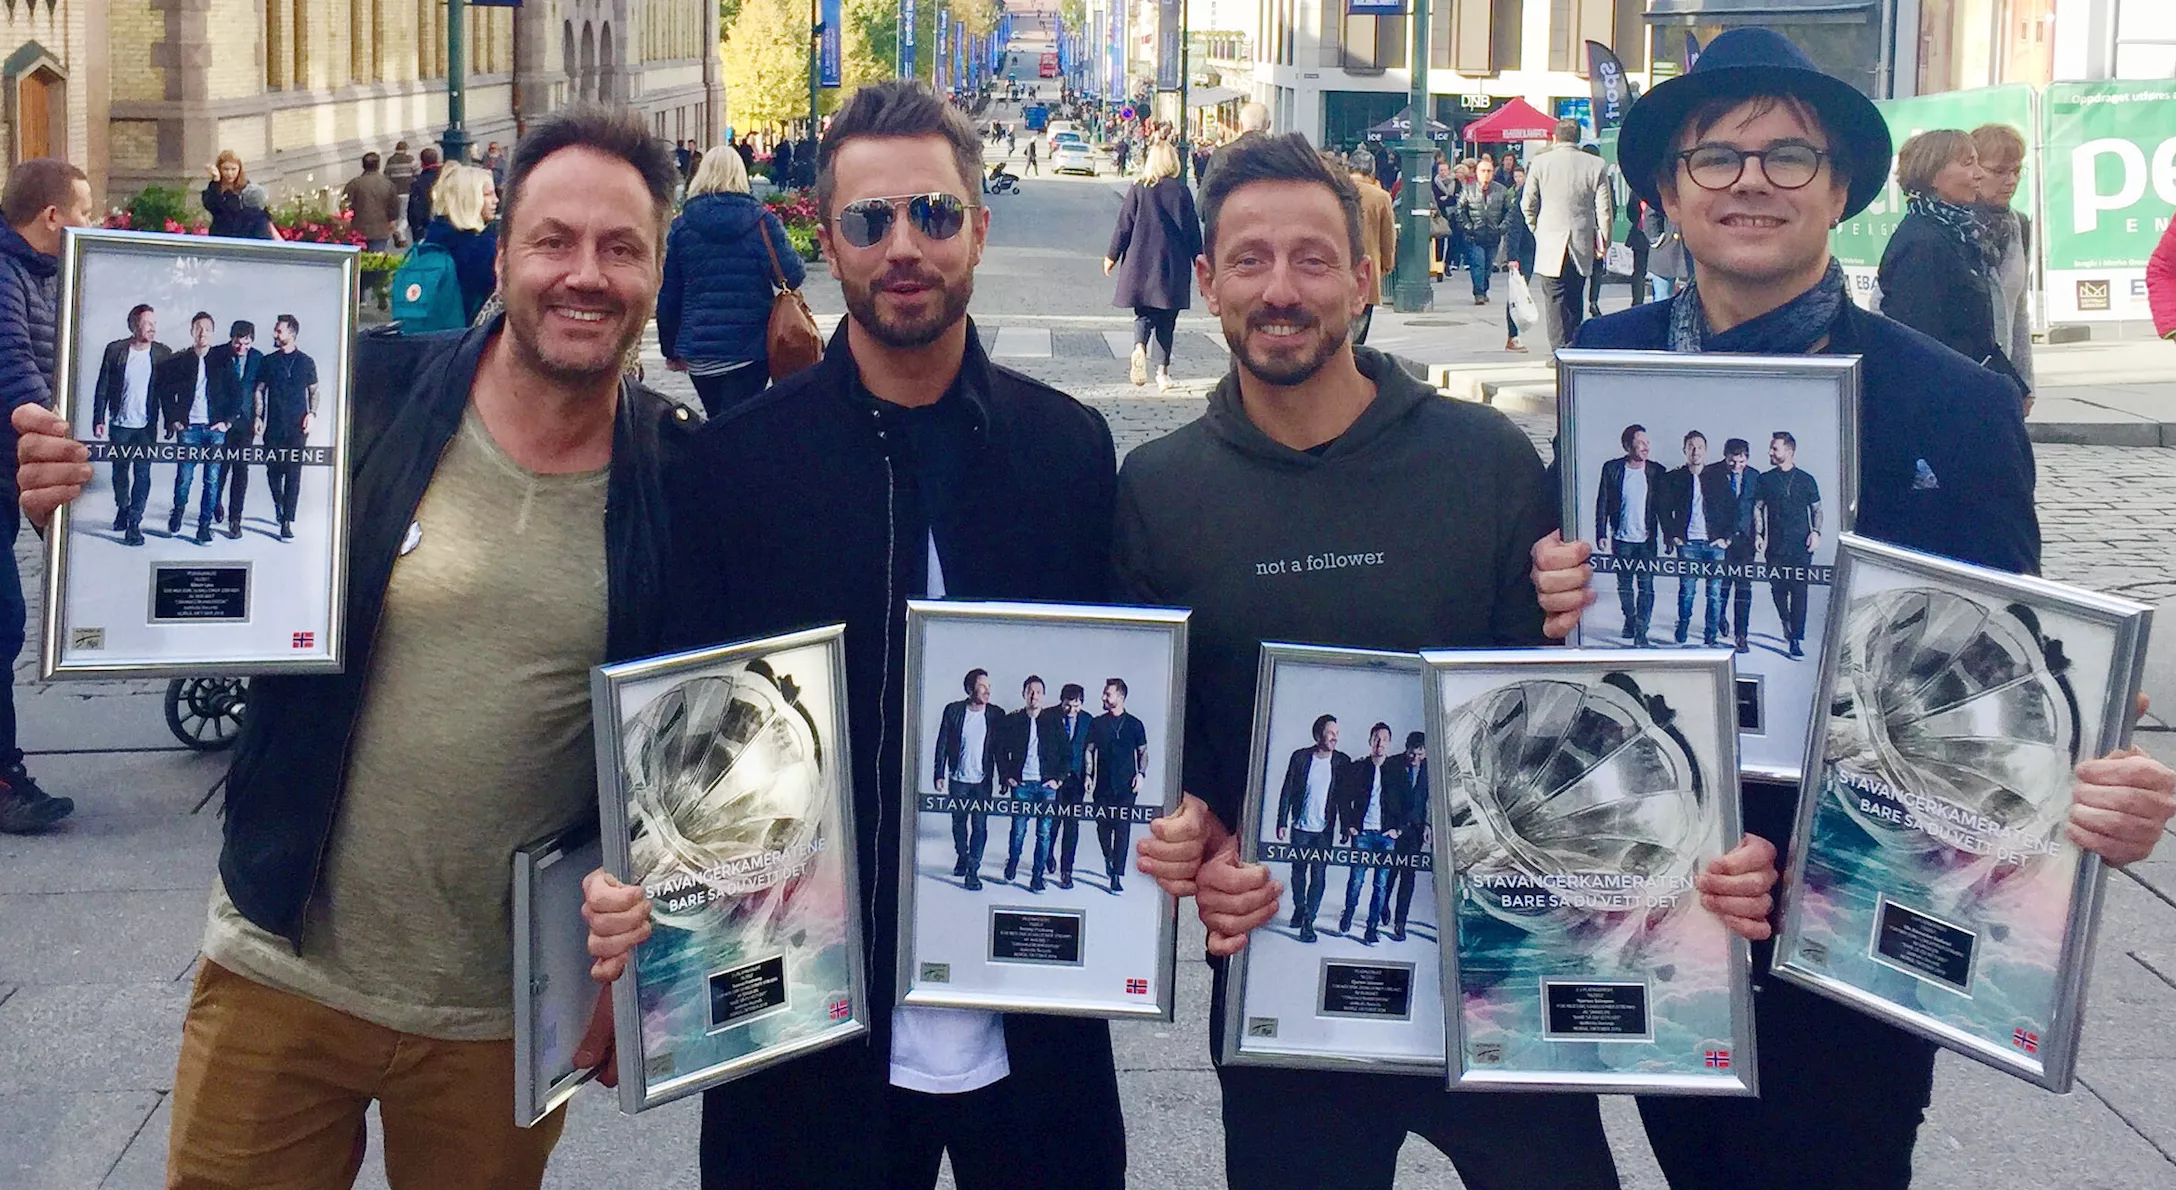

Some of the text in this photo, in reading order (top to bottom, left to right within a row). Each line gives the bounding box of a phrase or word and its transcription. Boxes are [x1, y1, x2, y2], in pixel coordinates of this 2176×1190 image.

[1461, 94, 1490, 110] DNB
[1367, 133, 1382, 141] ice
[1434, 132, 1449, 141] ice
[85, 444, 325, 463] STAVANGERKAMERATENE
[1255, 551, 1385, 575] not a follower
[1589, 556, 1832, 582] STAVANGERKAMERATENE
[926, 796, 1153, 821] STAVANGERKAMERATENE
[1838, 770, 2061, 858] STAVANGERKAMERATENE
[1859, 798, 1902, 824] BARE
[1926, 820, 1950, 839] DU
[1951, 829, 1993, 856] VETT
[1996, 846, 2030, 868] DET
[646, 838, 825, 899] STAVANGERKAMERATENE
[669, 891, 707, 913] BARE
[727, 881, 747, 896] DU
[747, 870, 781, 891] VETT
[782, 863, 808, 880] DET
[1473, 874, 1698, 889] STAVANGERKAMERATEN
[1501, 894, 1545, 908] BARE
[1573, 895, 1597, 908] DU
[1600, 895, 1644, 908] VETT
[1647, 896, 1678, 909] DET
